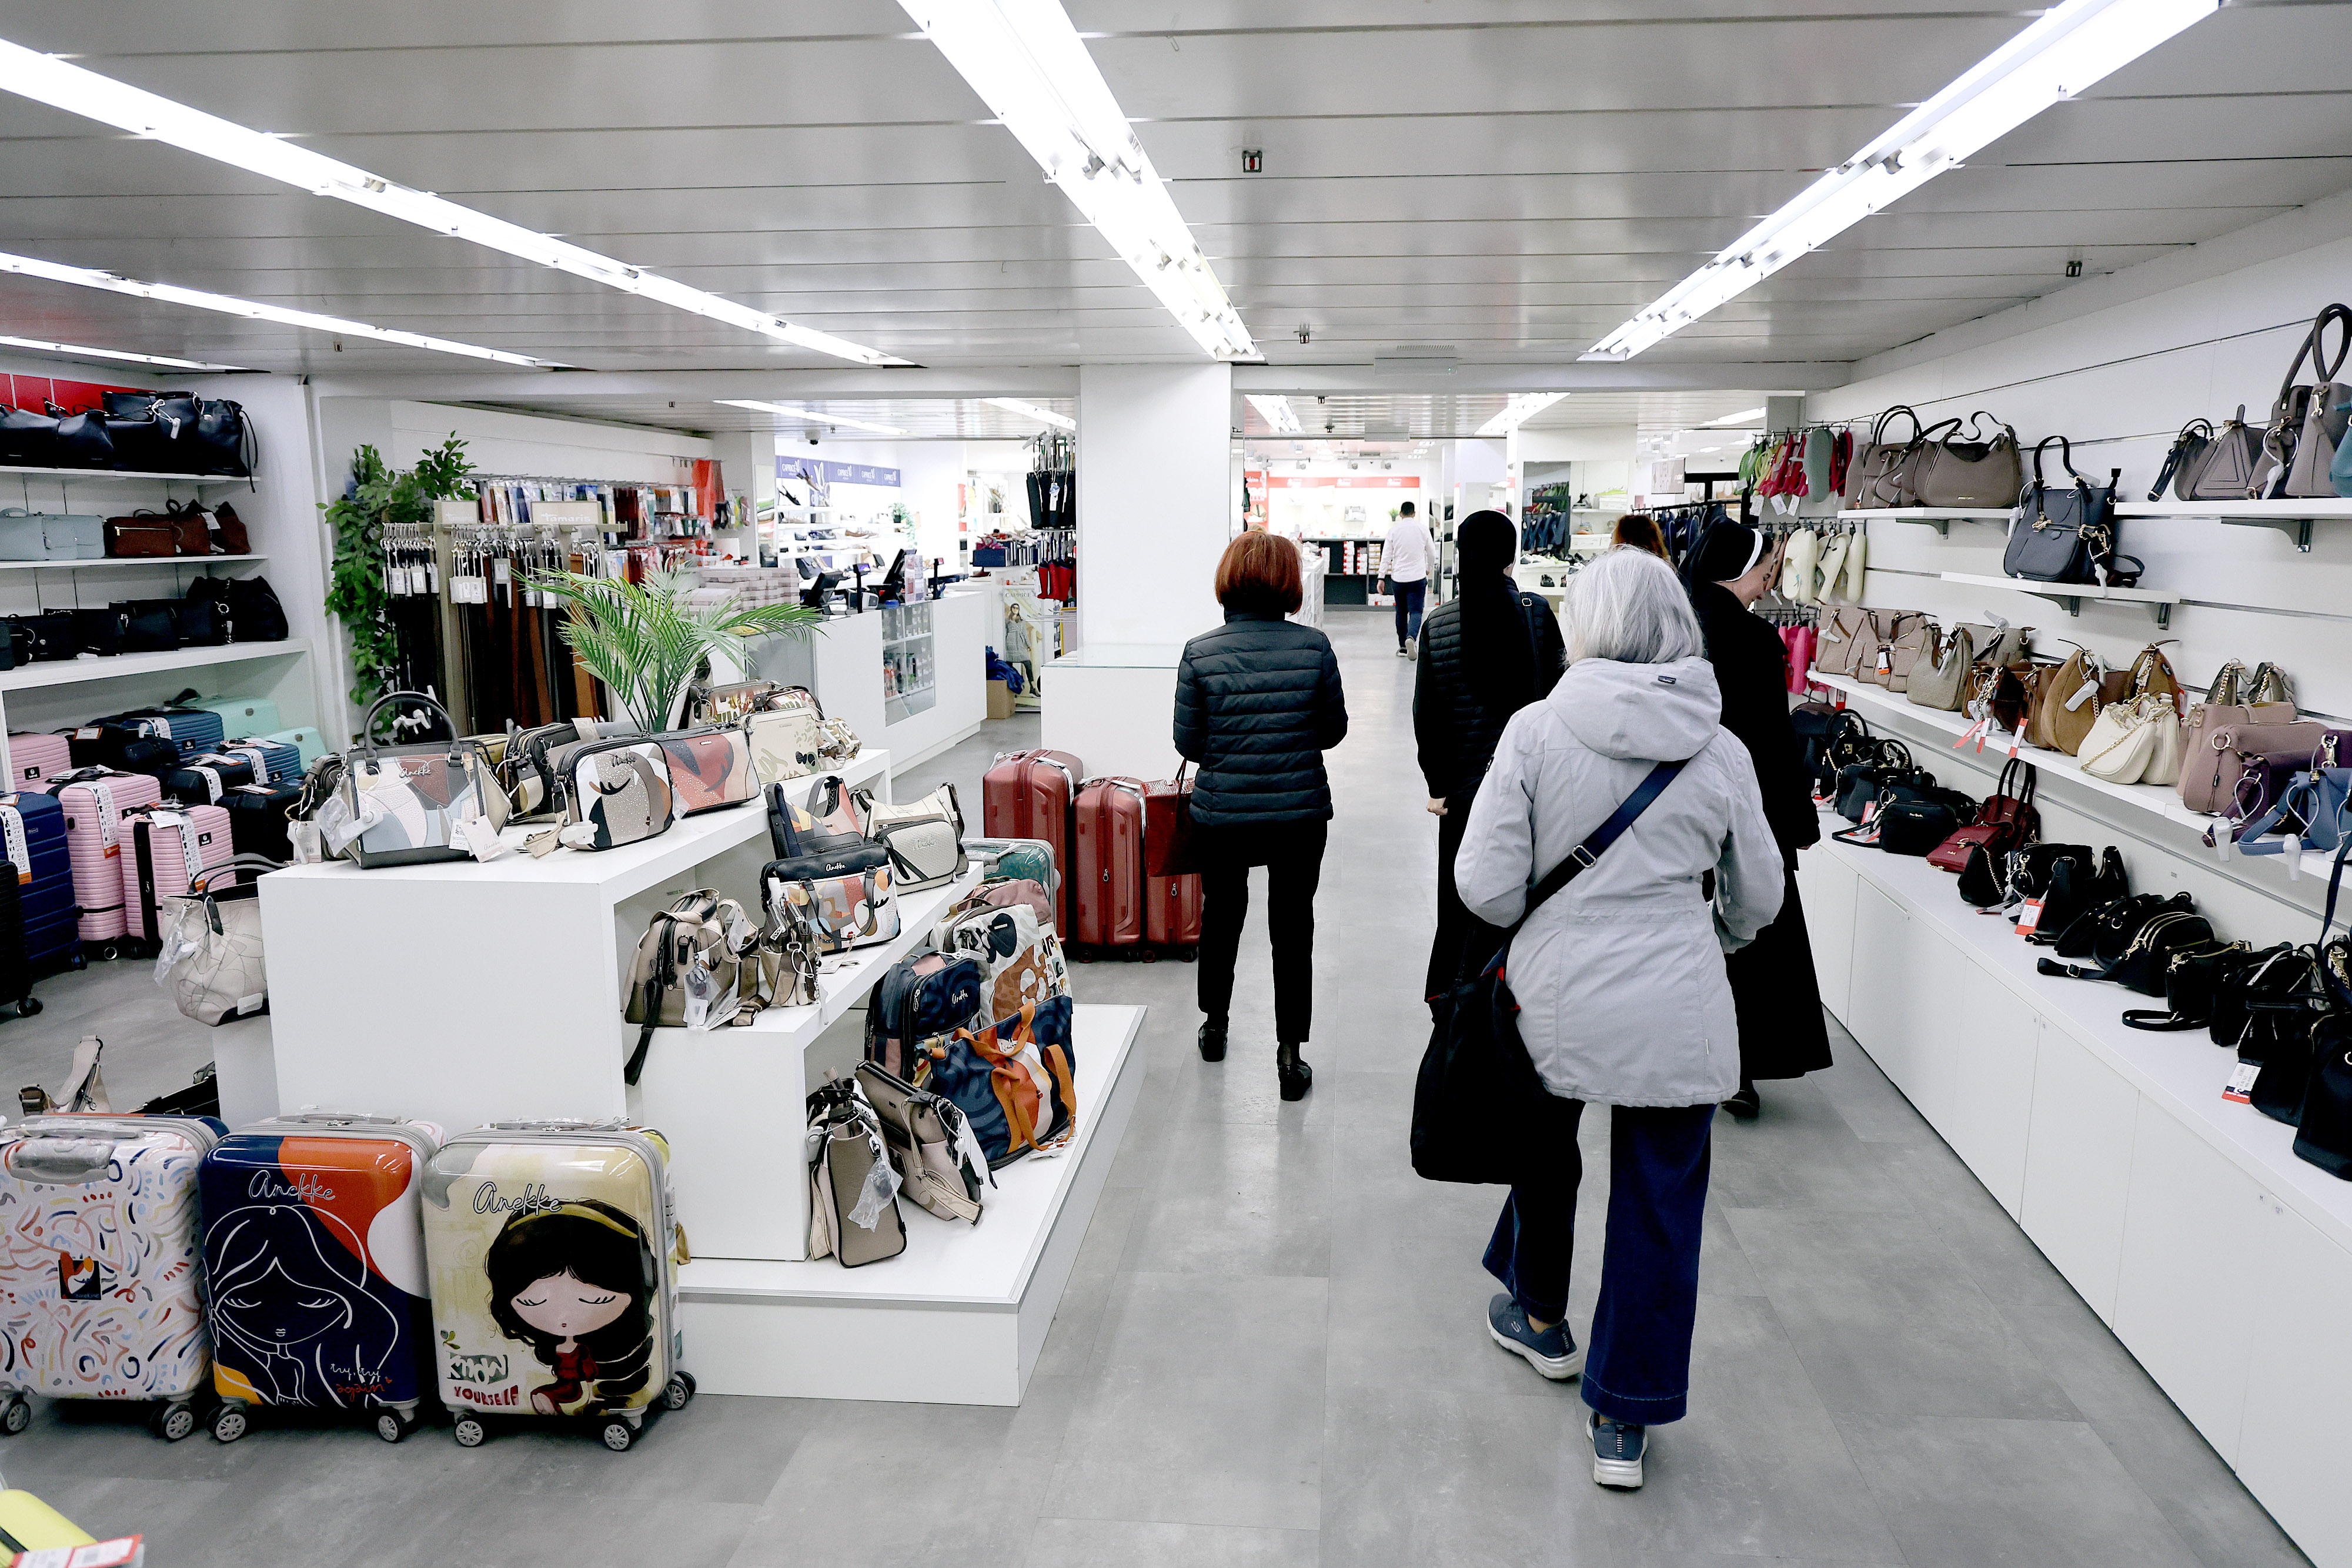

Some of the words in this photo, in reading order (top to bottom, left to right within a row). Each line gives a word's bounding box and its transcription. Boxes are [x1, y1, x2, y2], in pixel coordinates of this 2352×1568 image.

[249, 1169, 336, 1203] Anekke
[473, 1181, 562, 1216] Anekke
[335, 1383, 385, 1402] again
[454, 1385, 519, 1406] YOURSELF
